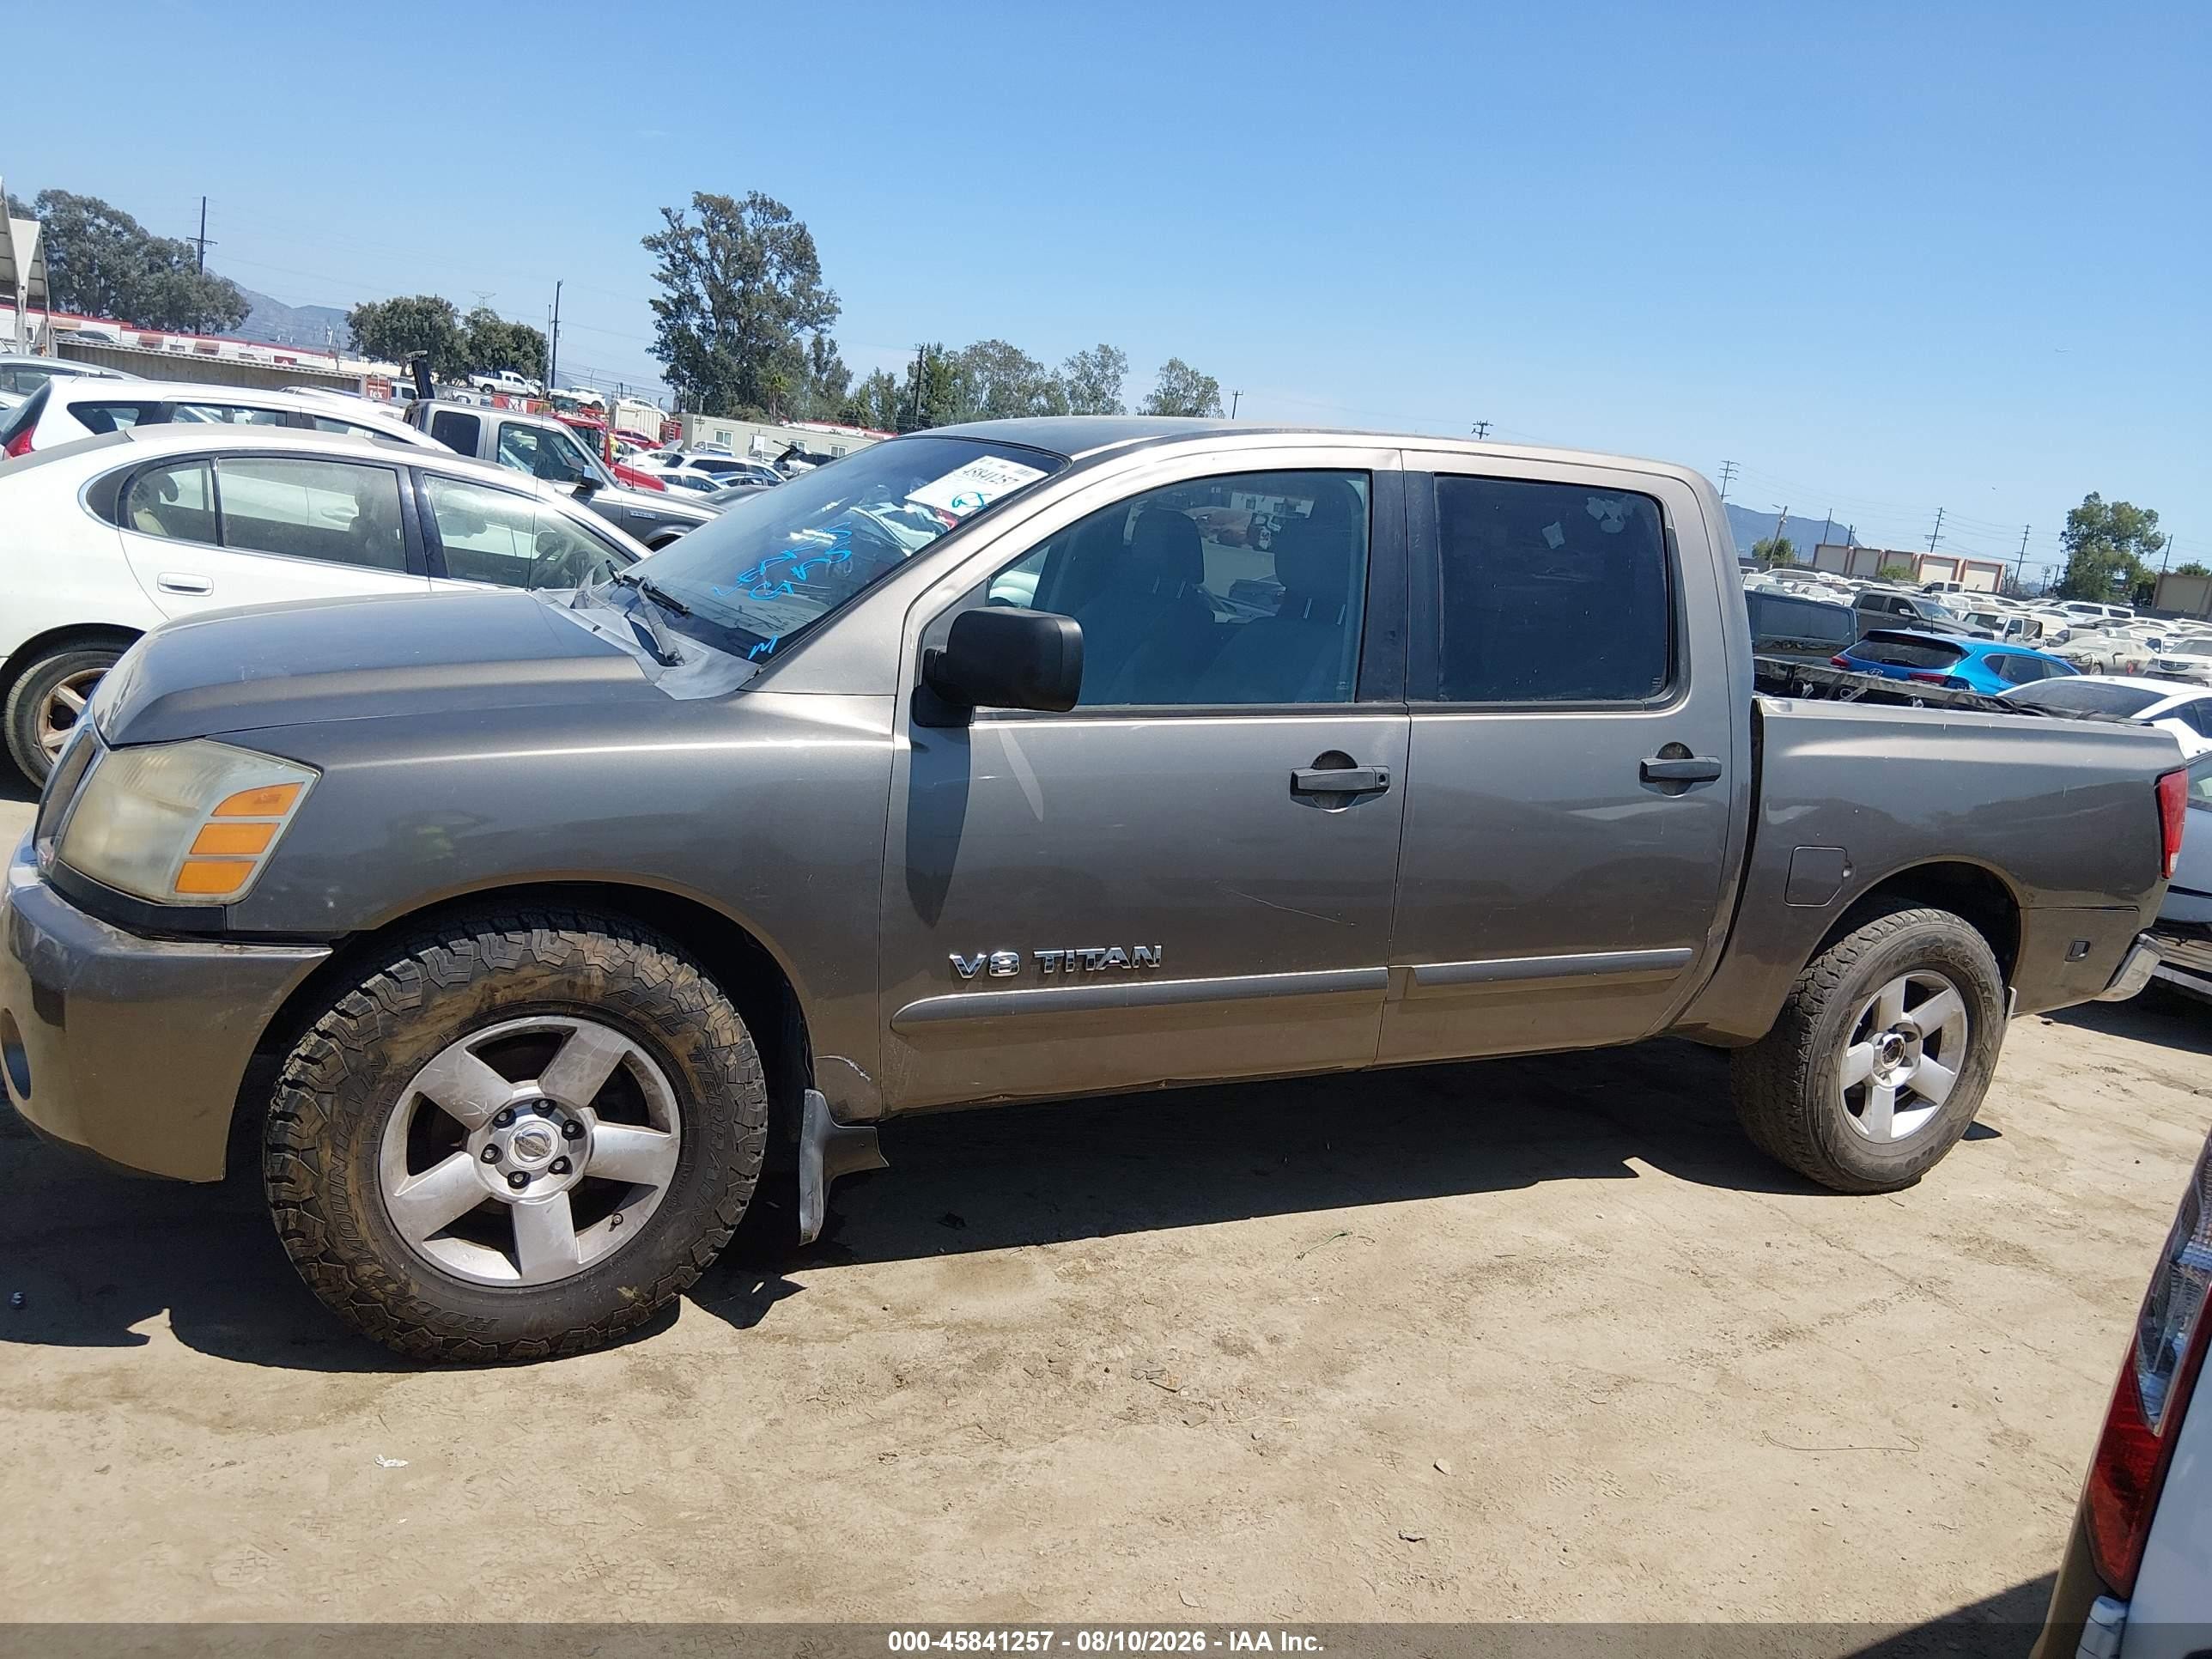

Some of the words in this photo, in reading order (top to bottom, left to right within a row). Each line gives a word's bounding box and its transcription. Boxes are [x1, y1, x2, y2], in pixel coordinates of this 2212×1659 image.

[948, 951, 1020, 979] V8
[1033, 945, 1162, 974] TITAN
[604, 988, 680, 1036] ALL
[520, 1136, 548, 1154] NISSAN
